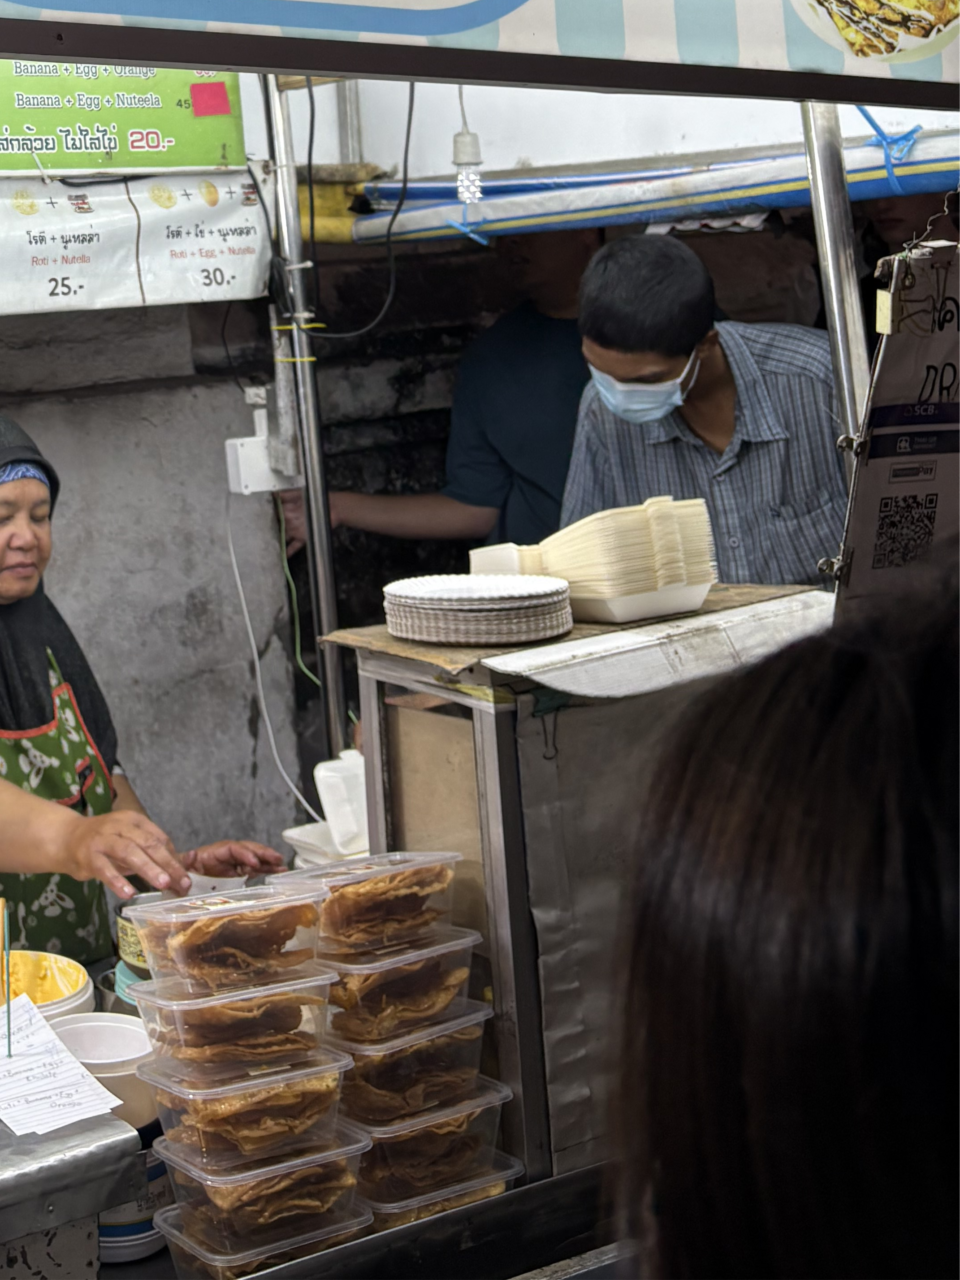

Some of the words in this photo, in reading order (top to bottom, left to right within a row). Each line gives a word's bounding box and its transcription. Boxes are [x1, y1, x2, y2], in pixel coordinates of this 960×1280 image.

[14, 61, 59, 76] Banana
[75, 64, 98, 78] Egg
[15, 93, 61, 108] Banana
[76, 93, 100, 110] Egg
[115, 93, 161, 108] Nuteela
[129, 131, 174, 151] 20.-
[31, 256, 50, 267] Roti
[61, 254, 91, 265] Nutella
[200, 268, 237, 287] 30.-
[48, 277, 85, 297] 25.-
